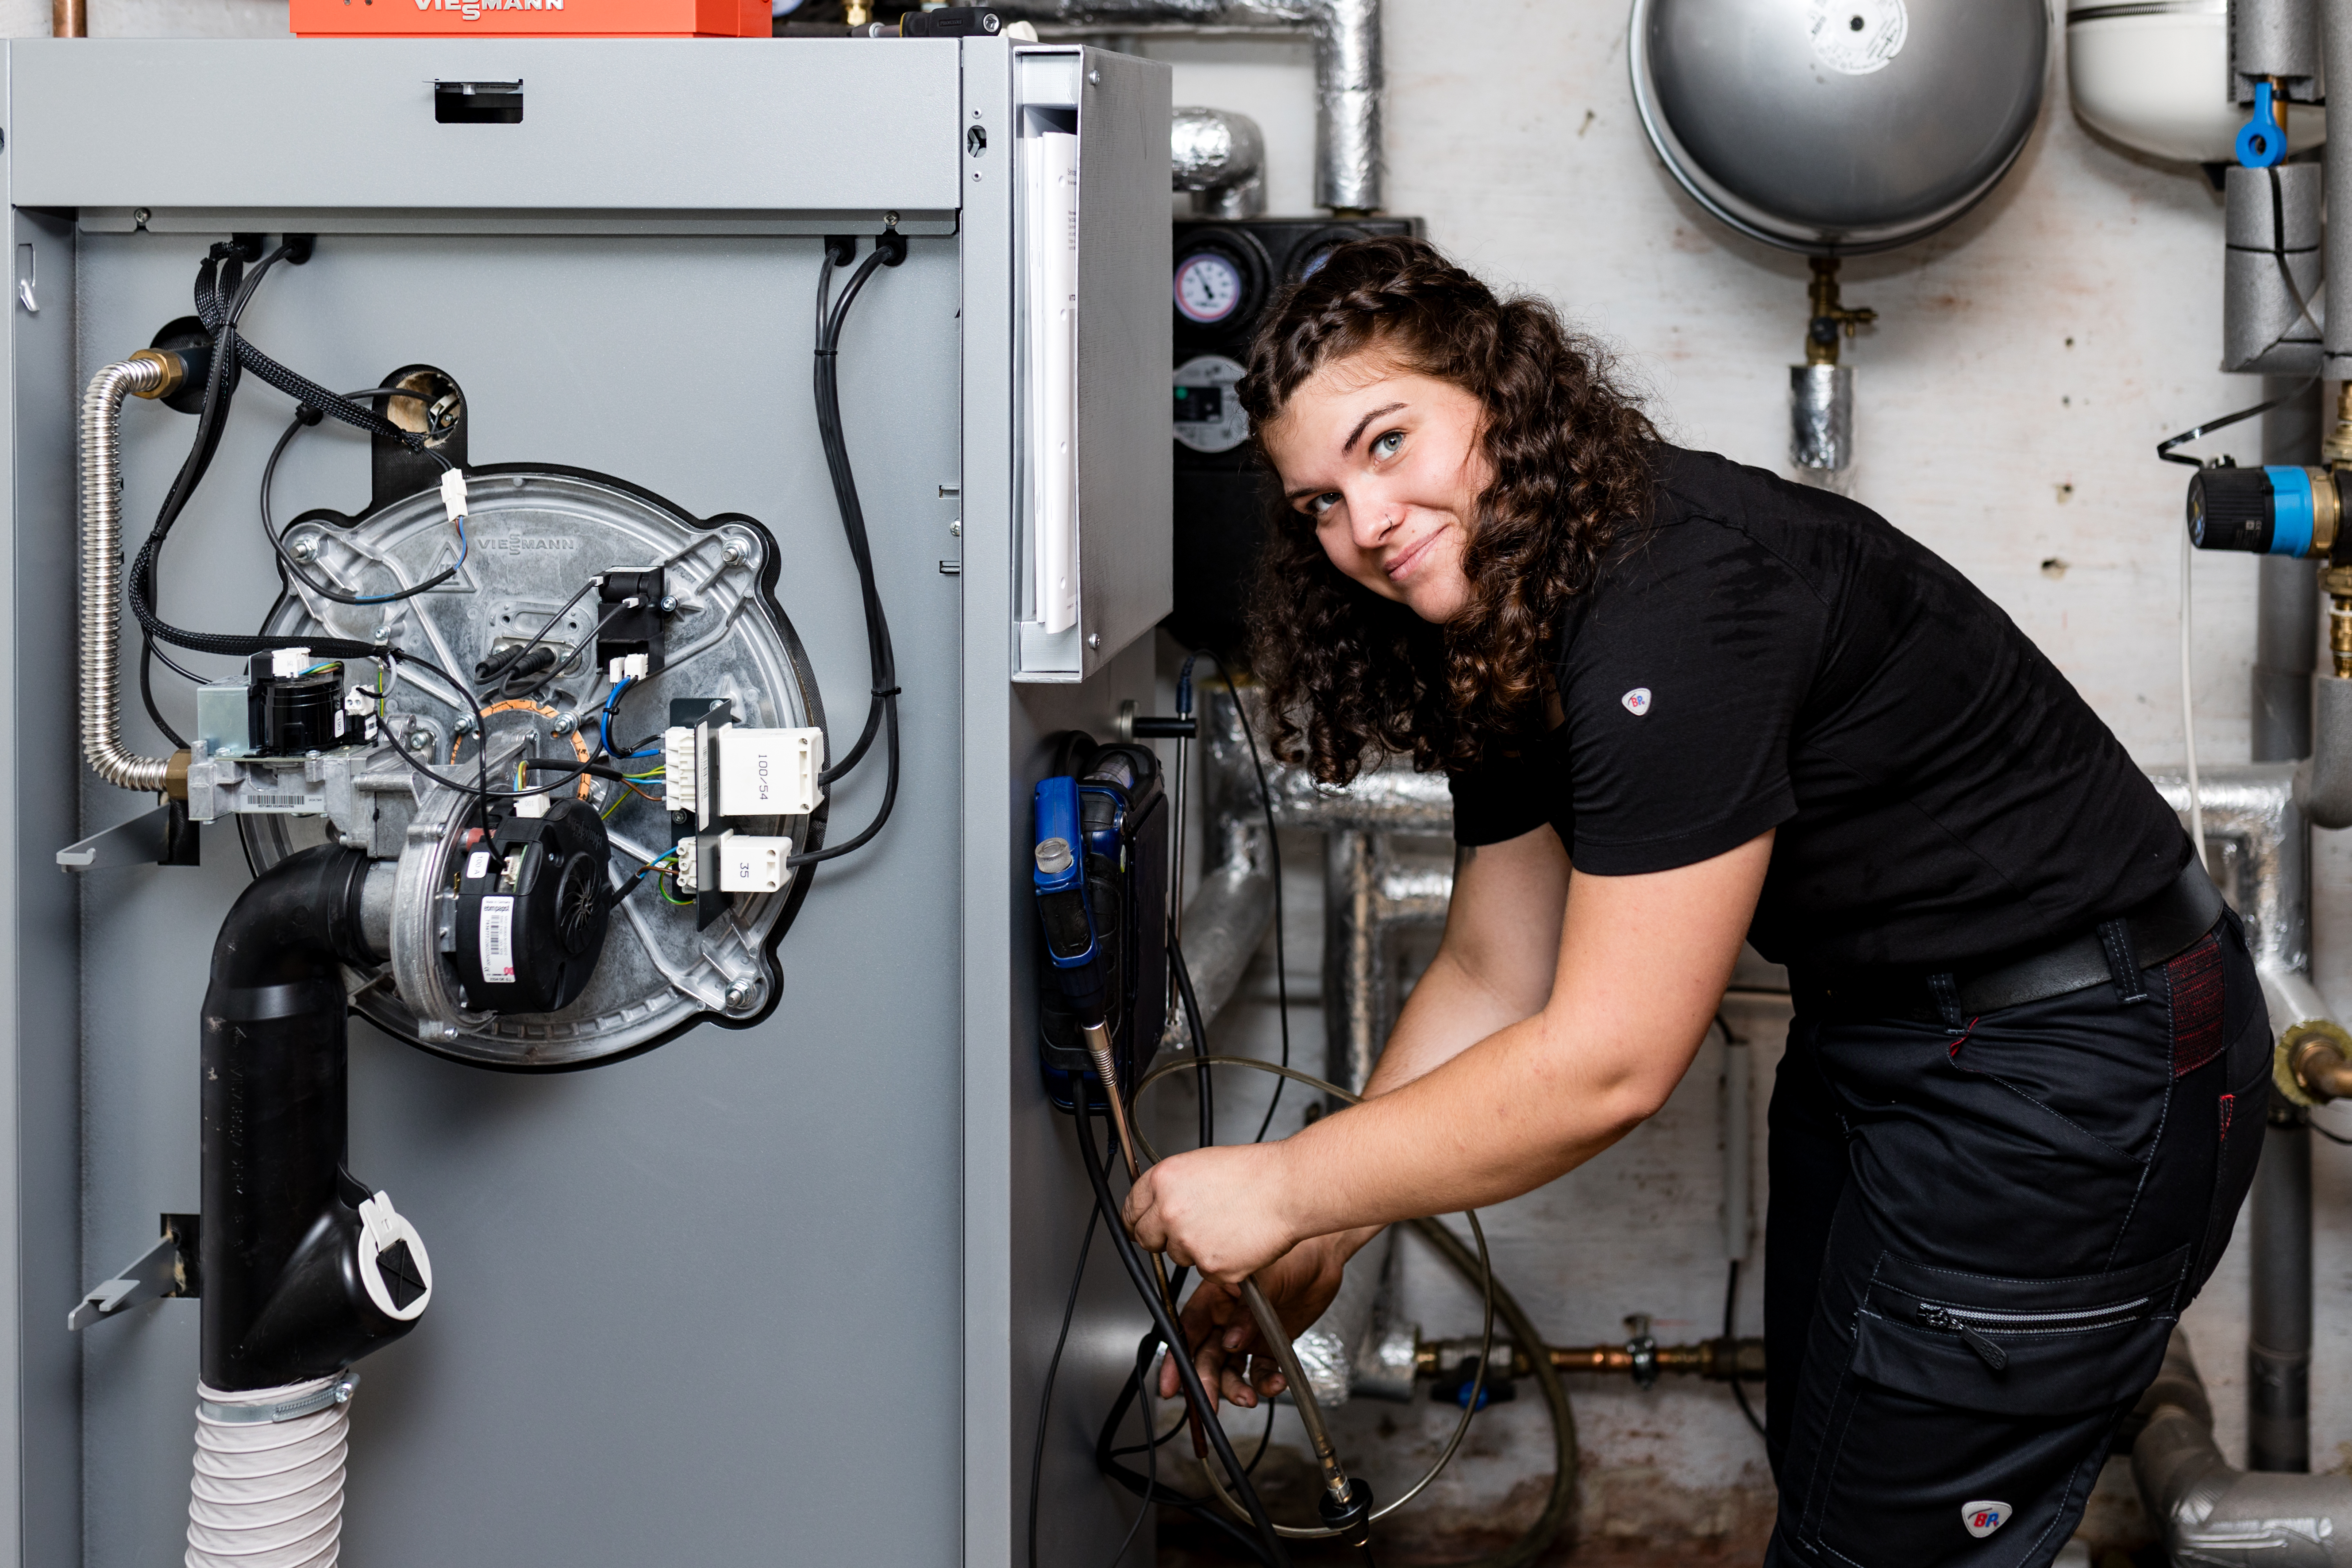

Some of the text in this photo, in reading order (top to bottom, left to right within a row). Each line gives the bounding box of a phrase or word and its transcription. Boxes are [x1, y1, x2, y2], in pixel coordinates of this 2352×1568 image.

[415, 0, 564, 20] VIESMANN
[477, 533, 574, 555] VIESSMANN
[758, 755, 768, 800] 100/54
[740, 863, 749, 878] 35
